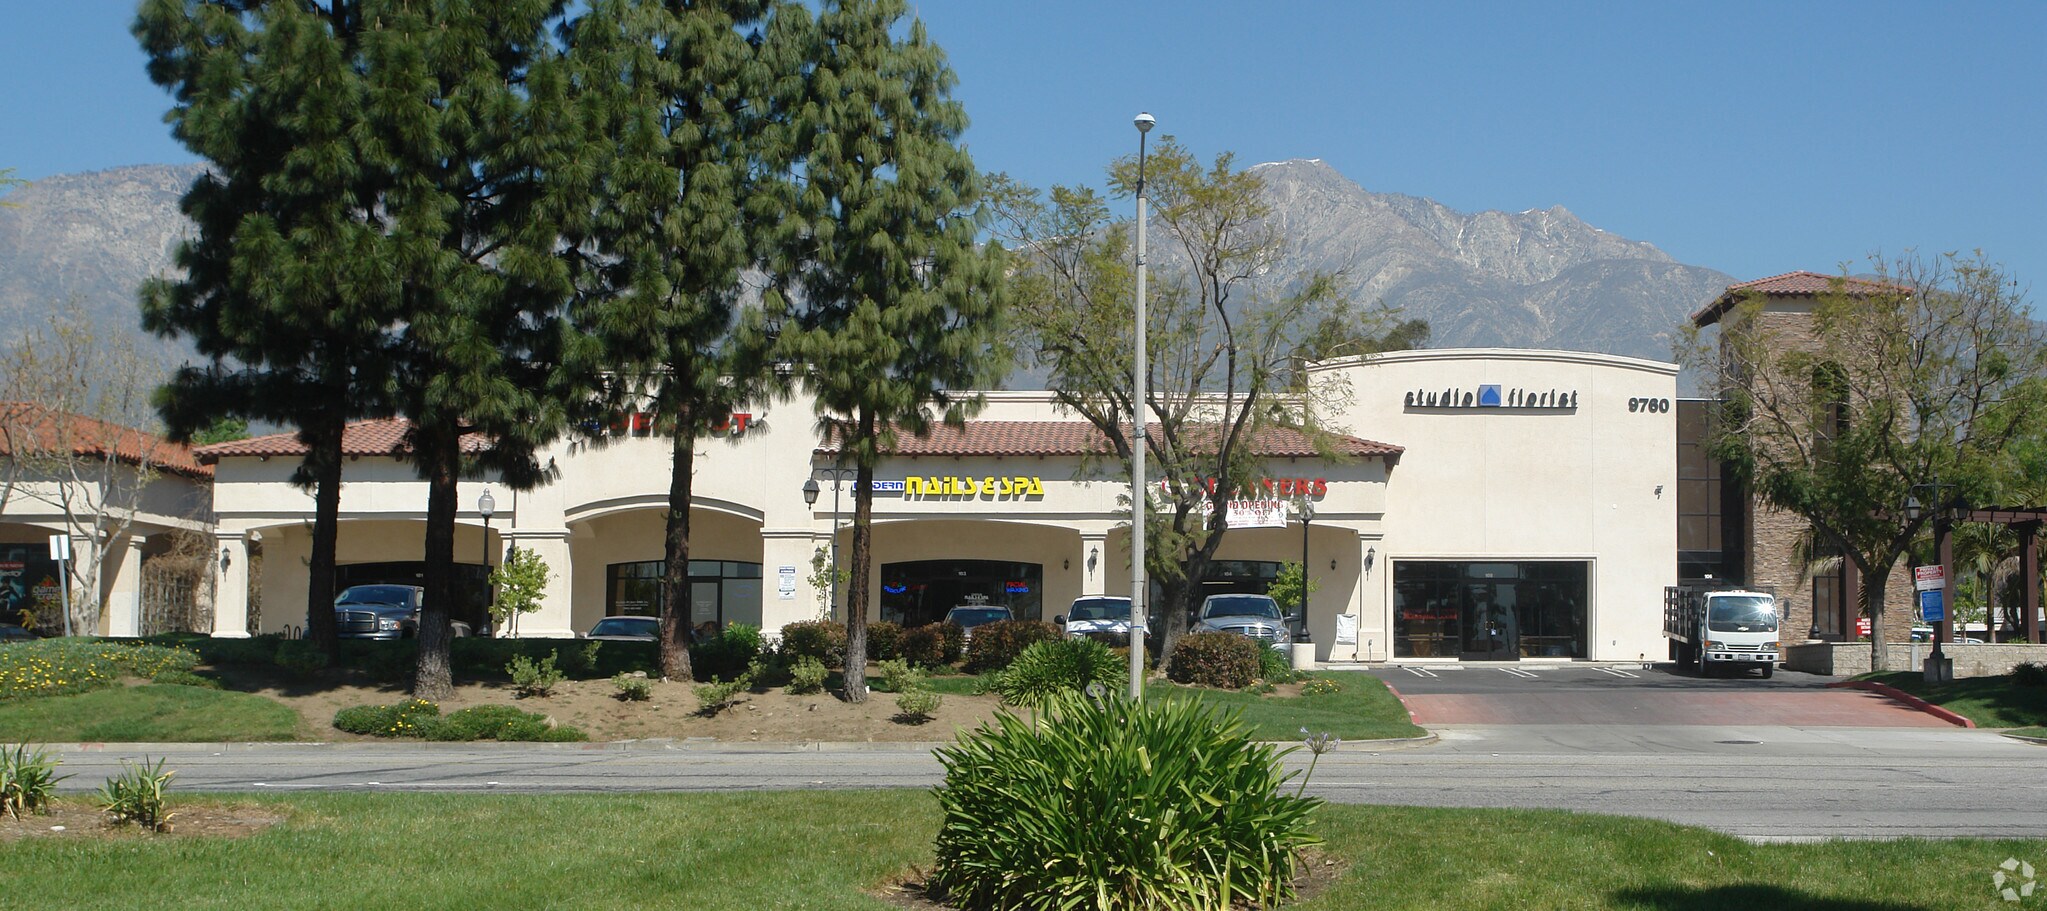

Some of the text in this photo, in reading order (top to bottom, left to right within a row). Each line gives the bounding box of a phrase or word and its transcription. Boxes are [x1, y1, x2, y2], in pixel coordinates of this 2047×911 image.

[1404, 388, 1578, 407] studio florist
[1628, 397, 1670, 414] 9760
[853, 481, 903, 490] DERN
[980, 476, 995, 495] &
[999, 476, 1045, 495] SPA
[1206, 500, 1284, 510] GND OPENING
